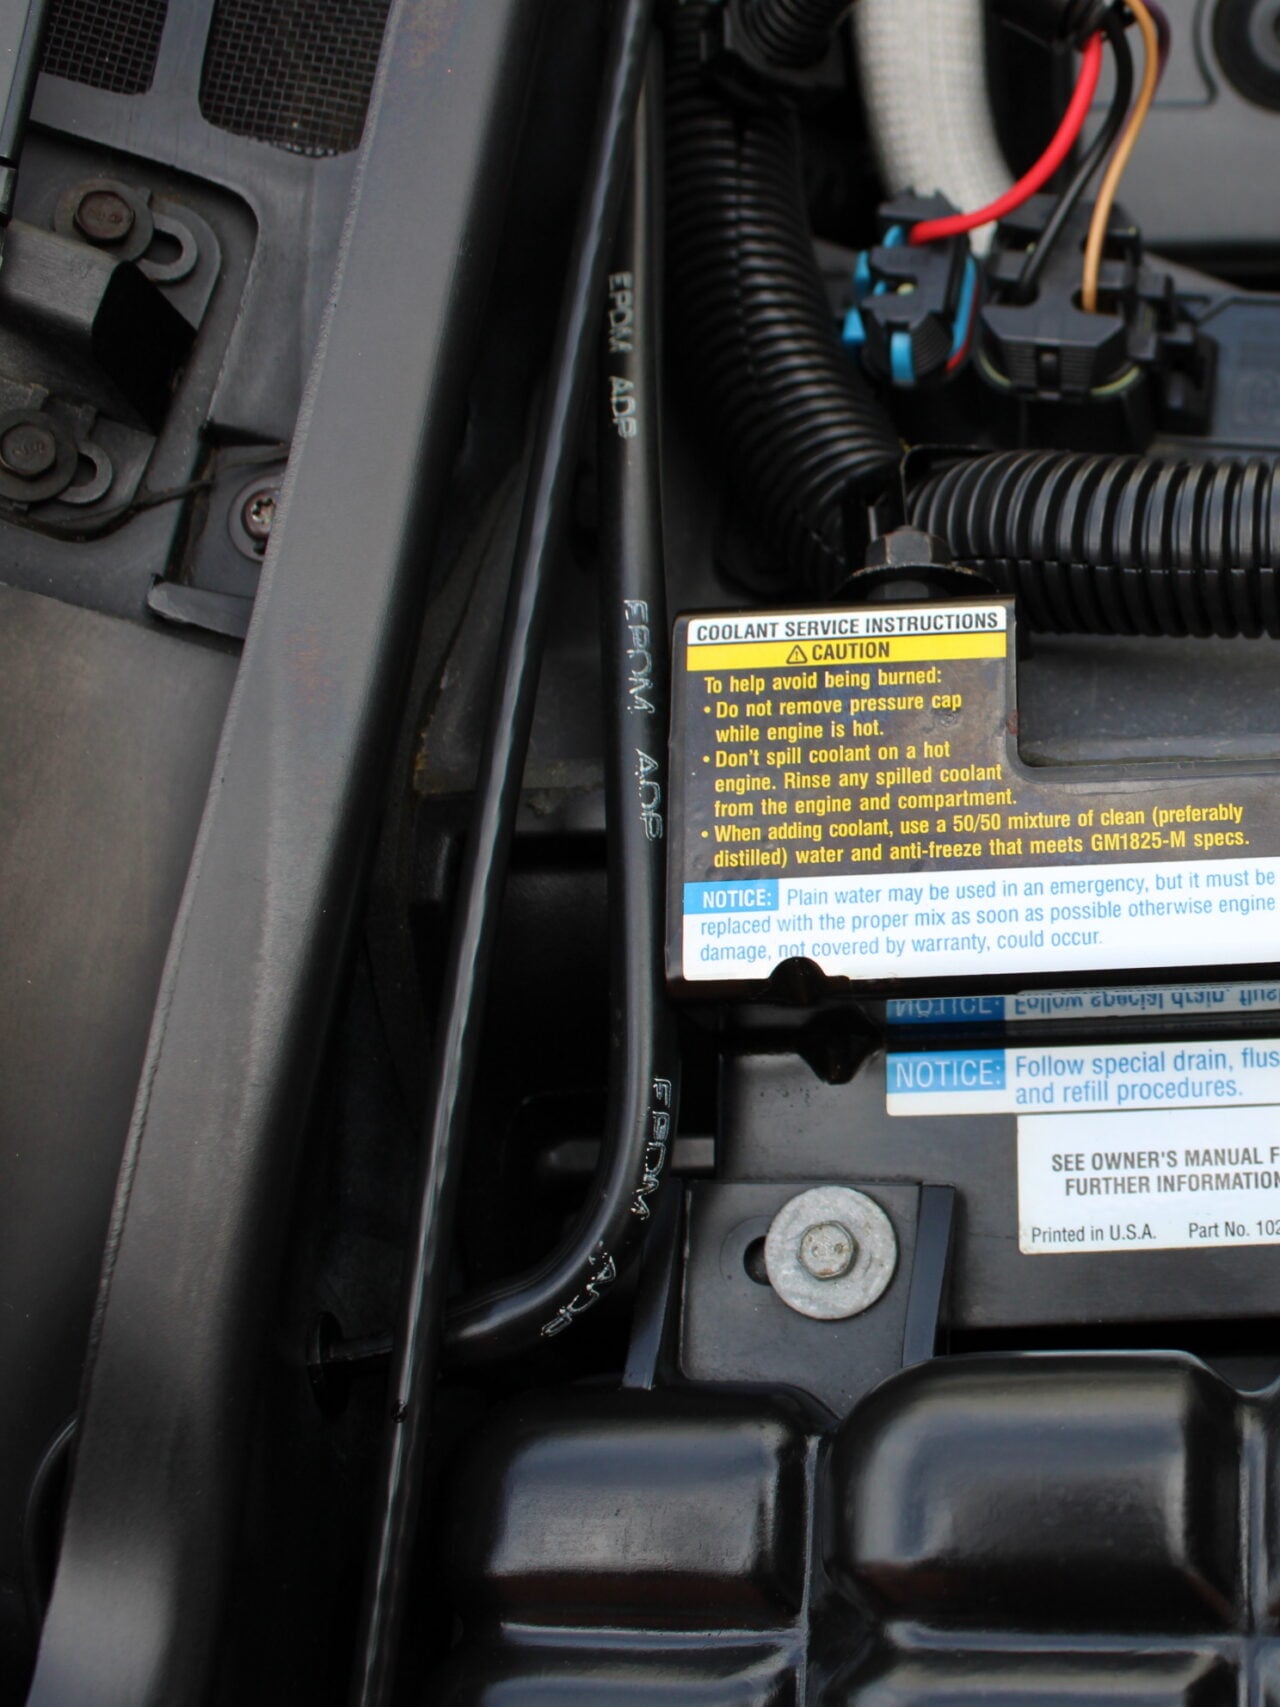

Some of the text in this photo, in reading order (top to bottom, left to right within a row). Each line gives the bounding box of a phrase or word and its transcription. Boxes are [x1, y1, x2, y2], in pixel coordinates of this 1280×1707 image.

[697, 612, 998, 641] COOLANT SERVICE INSTRUCTIONS
[812, 642, 890, 662] CAUTION
[703, 665, 942, 695] To help avoid being burned:
[715, 693, 962, 718] Do not remove pressure cap
[715, 719, 884, 743] while engine is hot.
[715, 740, 950, 769] Don't spill coolant on a hot
[714, 763, 1002, 795] engine. Rinse any spilled coolant
[713, 787, 1017, 817] from the engine and compartment.
[713, 802, 1243, 842] When adding coolant, use a 50/50 mixture of clean (preferably
[713, 829, 1250, 868] distilled) water and anti-freeze that meets GM1825-M specs.
[702, 868, 1275, 908] NOTICE: Plain water may be used in an emergency, but it must be
[700, 896, 1276, 939] replaced with the proper mix as soon as possible otherwise engine
[699, 929, 1103, 963] damage, not covered by warranty, could occur.
[896, 1060, 1001, 1089] NOTICE:
[1015, 1054, 1085, 1077] Follow
[1091, 1050, 1165, 1079] special
[1172, 1048, 1233, 1072] drain,
[1015, 1076, 1242, 1105] and refill procedures.
[1051, 1153, 1085, 1172] SEE
[1090, 1149, 1178, 1171] OWNER'S
[1184, 1146, 1264, 1167] MANUAL
[1064, 1175, 1150, 1196] FURTHER
[1031, 1223, 1156, 1243] Printed in U.S.A.
[1188, 1222, 1220, 1239] Part
[1224, 1220, 1250, 1237] No.
